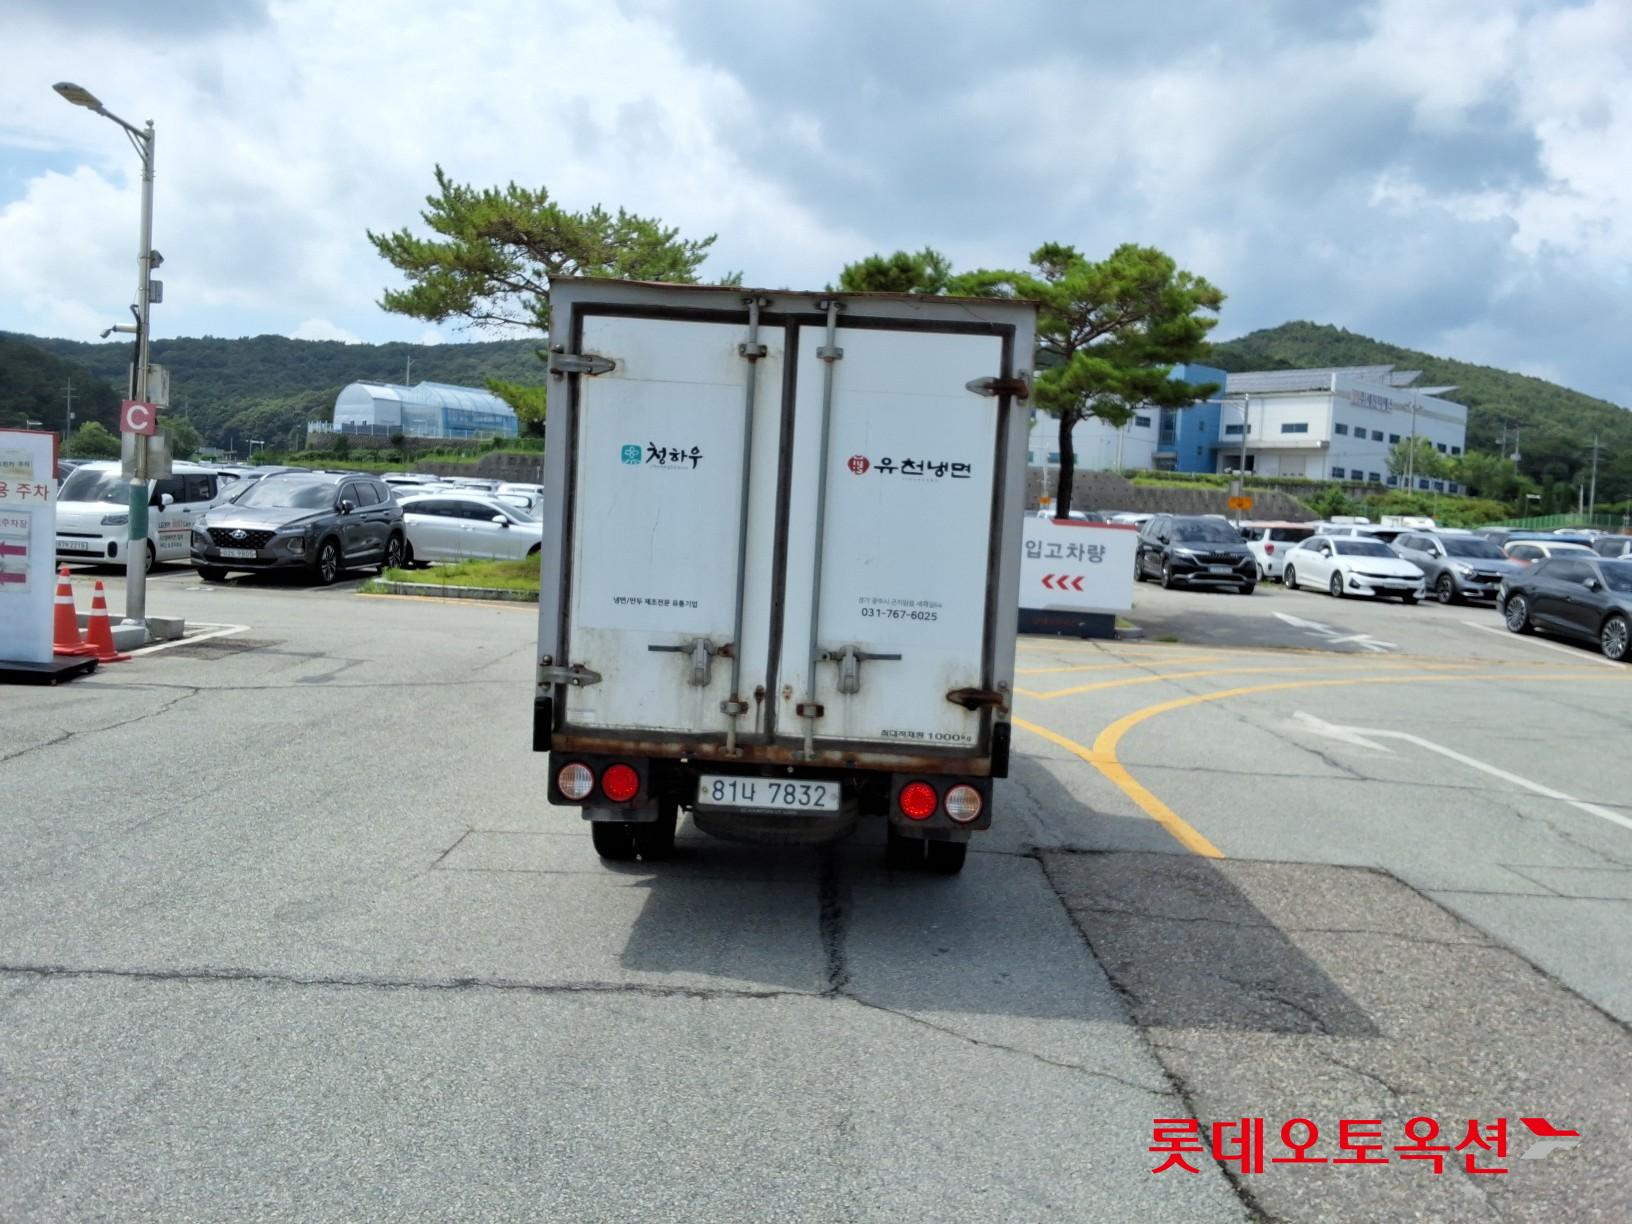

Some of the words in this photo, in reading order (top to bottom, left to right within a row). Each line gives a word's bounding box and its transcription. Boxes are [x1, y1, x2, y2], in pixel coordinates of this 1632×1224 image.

[126, 404, 149, 430] C
[645, 441, 703, 469] 청하우
[873, 457, 971, 478] 유천냉면
[16, 483, 50, 501] 주차
[1025, 540, 1106, 563] 입고차량
[861, 607, 938, 621] 031-767-6025
[712, 780, 755, 802] 81나
[768, 782, 826, 807] 7832
